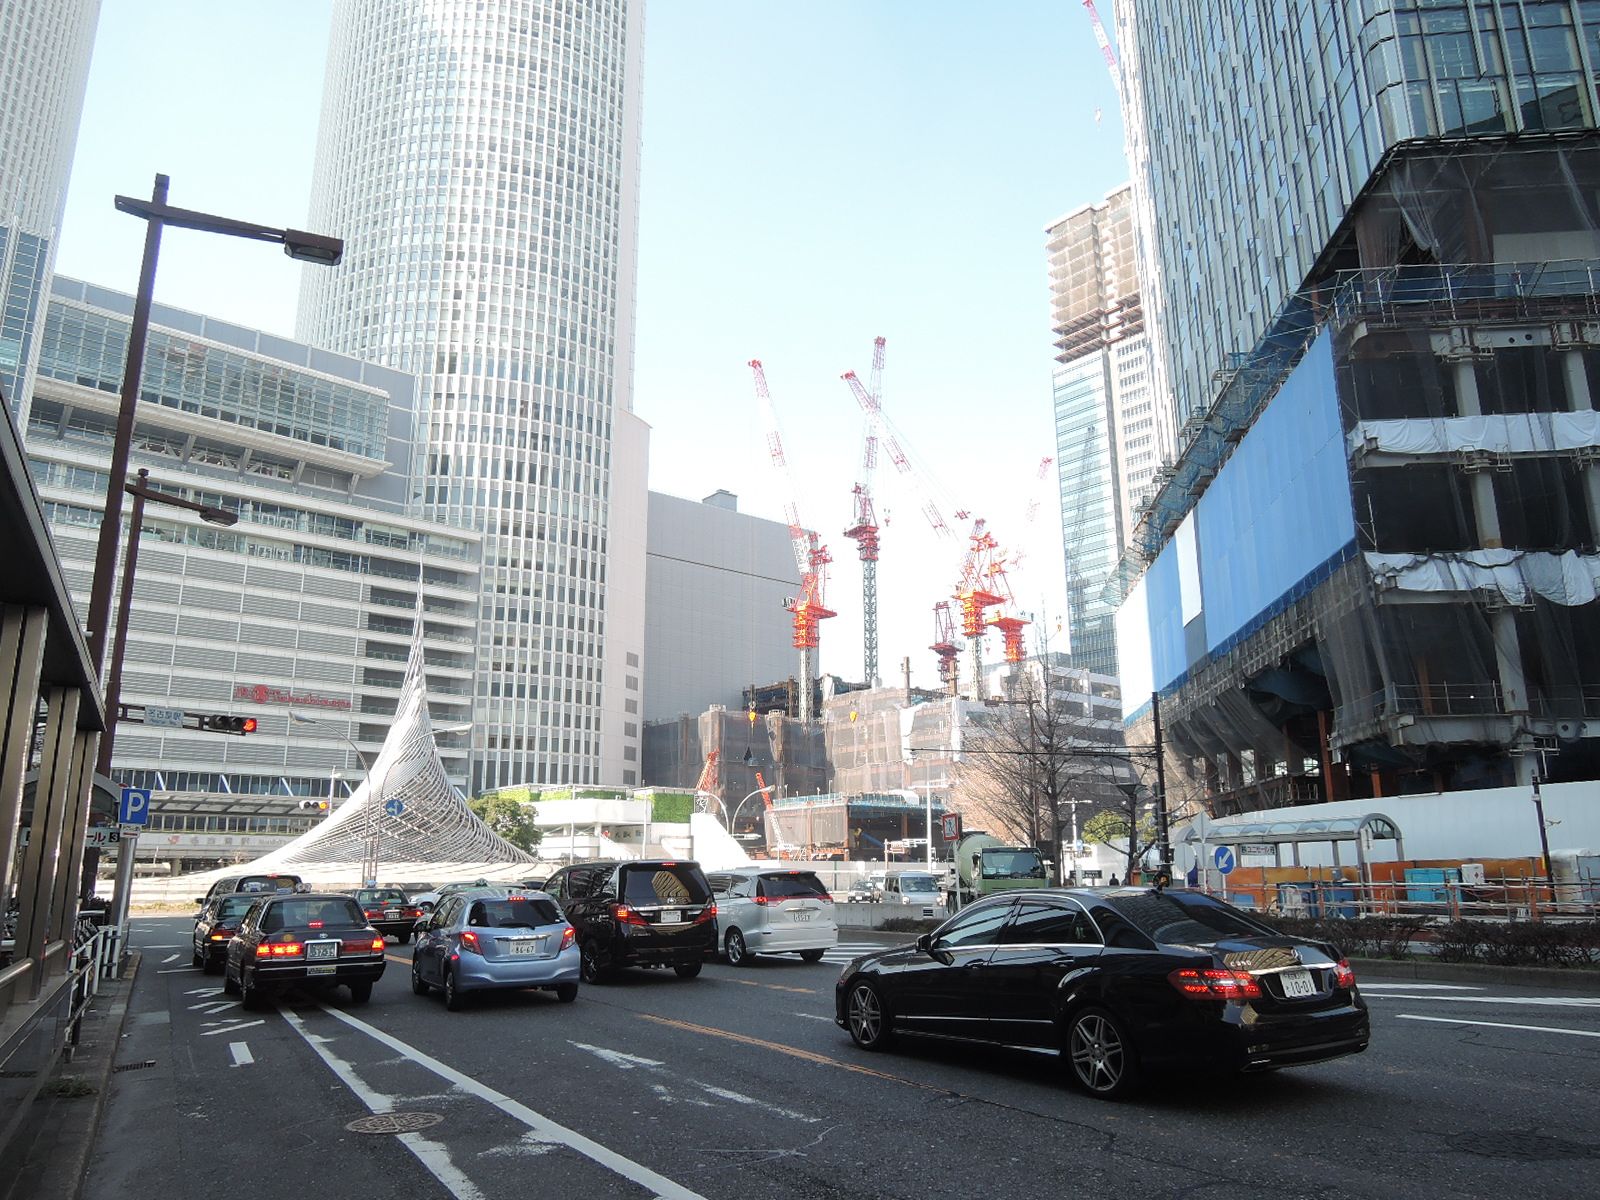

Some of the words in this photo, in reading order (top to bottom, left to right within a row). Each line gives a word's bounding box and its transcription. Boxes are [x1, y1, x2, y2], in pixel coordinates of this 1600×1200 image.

[126, 792, 145, 820] P
[111, 832, 118, 842] 3
[1290, 980, 1314, 995] 10-01
